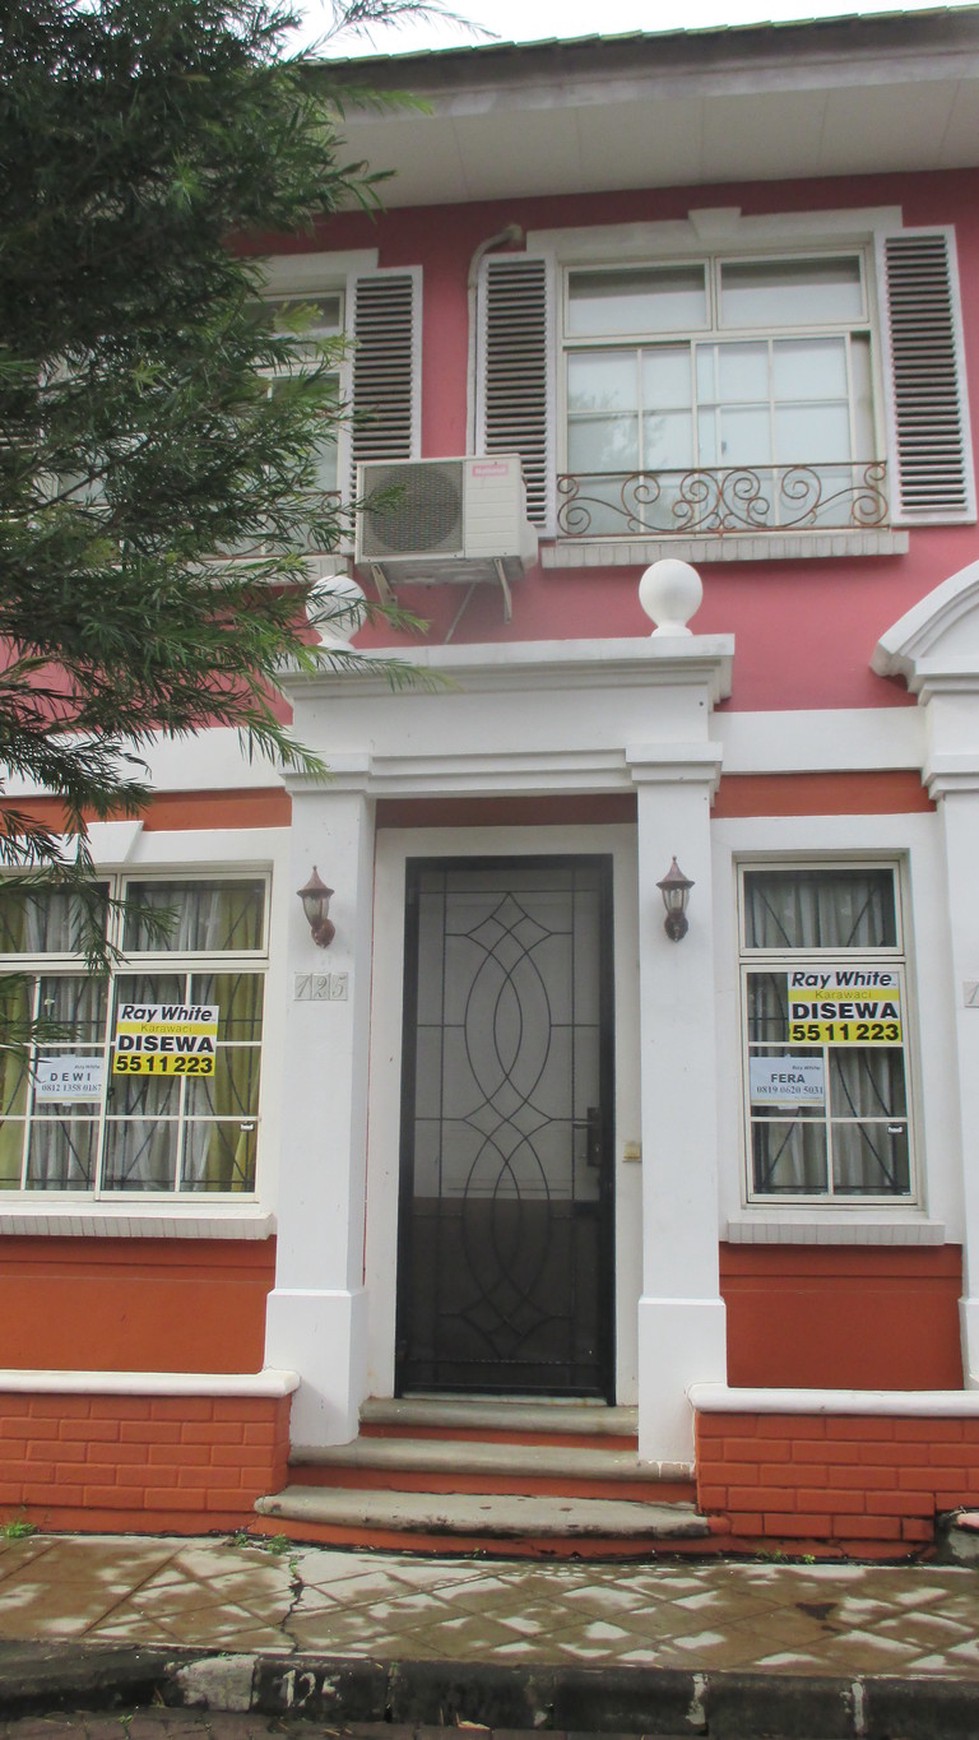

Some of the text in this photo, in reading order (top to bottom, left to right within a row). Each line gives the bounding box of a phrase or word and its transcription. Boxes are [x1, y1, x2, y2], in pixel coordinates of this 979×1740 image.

[791, 971, 892, 989] Ray White
[815, 990, 872, 999] Karawaci
[121, 1005, 212, 1022] Ray White
[792, 1002, 899, 1019] DISEWA
[140, 1024, 192, 1033] Karawaci
[118, 1035, 214, 1052] DISEWA
[50, 1072, 91, 1082] DEWI
[770, 1073, 806, 1083] FERA
